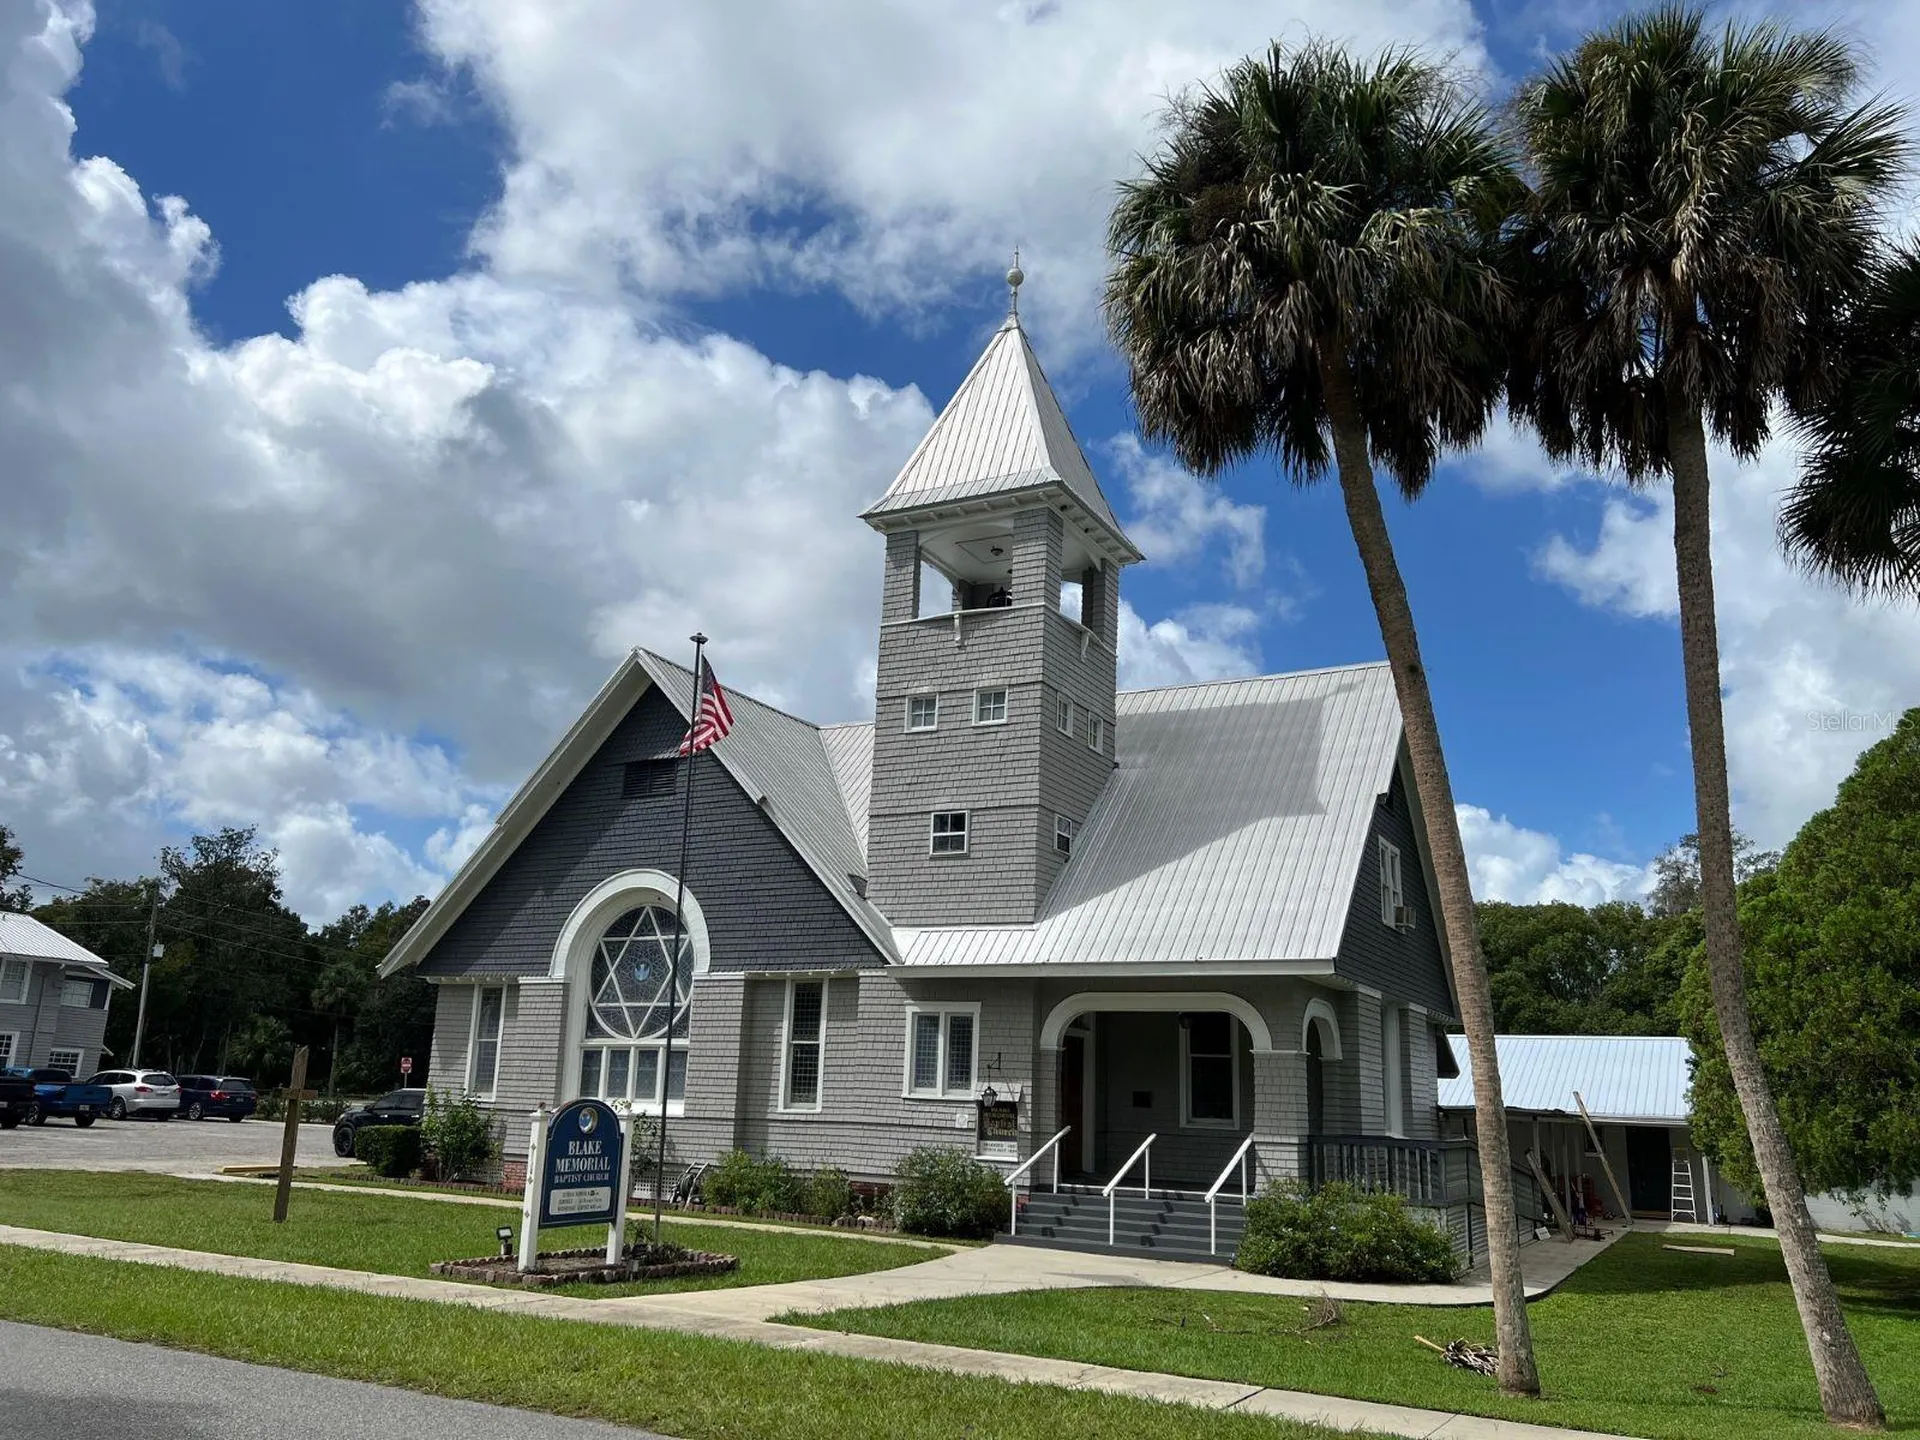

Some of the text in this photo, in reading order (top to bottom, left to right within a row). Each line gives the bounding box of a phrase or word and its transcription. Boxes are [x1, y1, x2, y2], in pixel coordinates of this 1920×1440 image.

[568, 1140, 602, 1155] BLAKE
[555, 1156, 611, 1173] MEMORIAL
[554, 1172, 609, 1184] BAPTIST CHURCH
